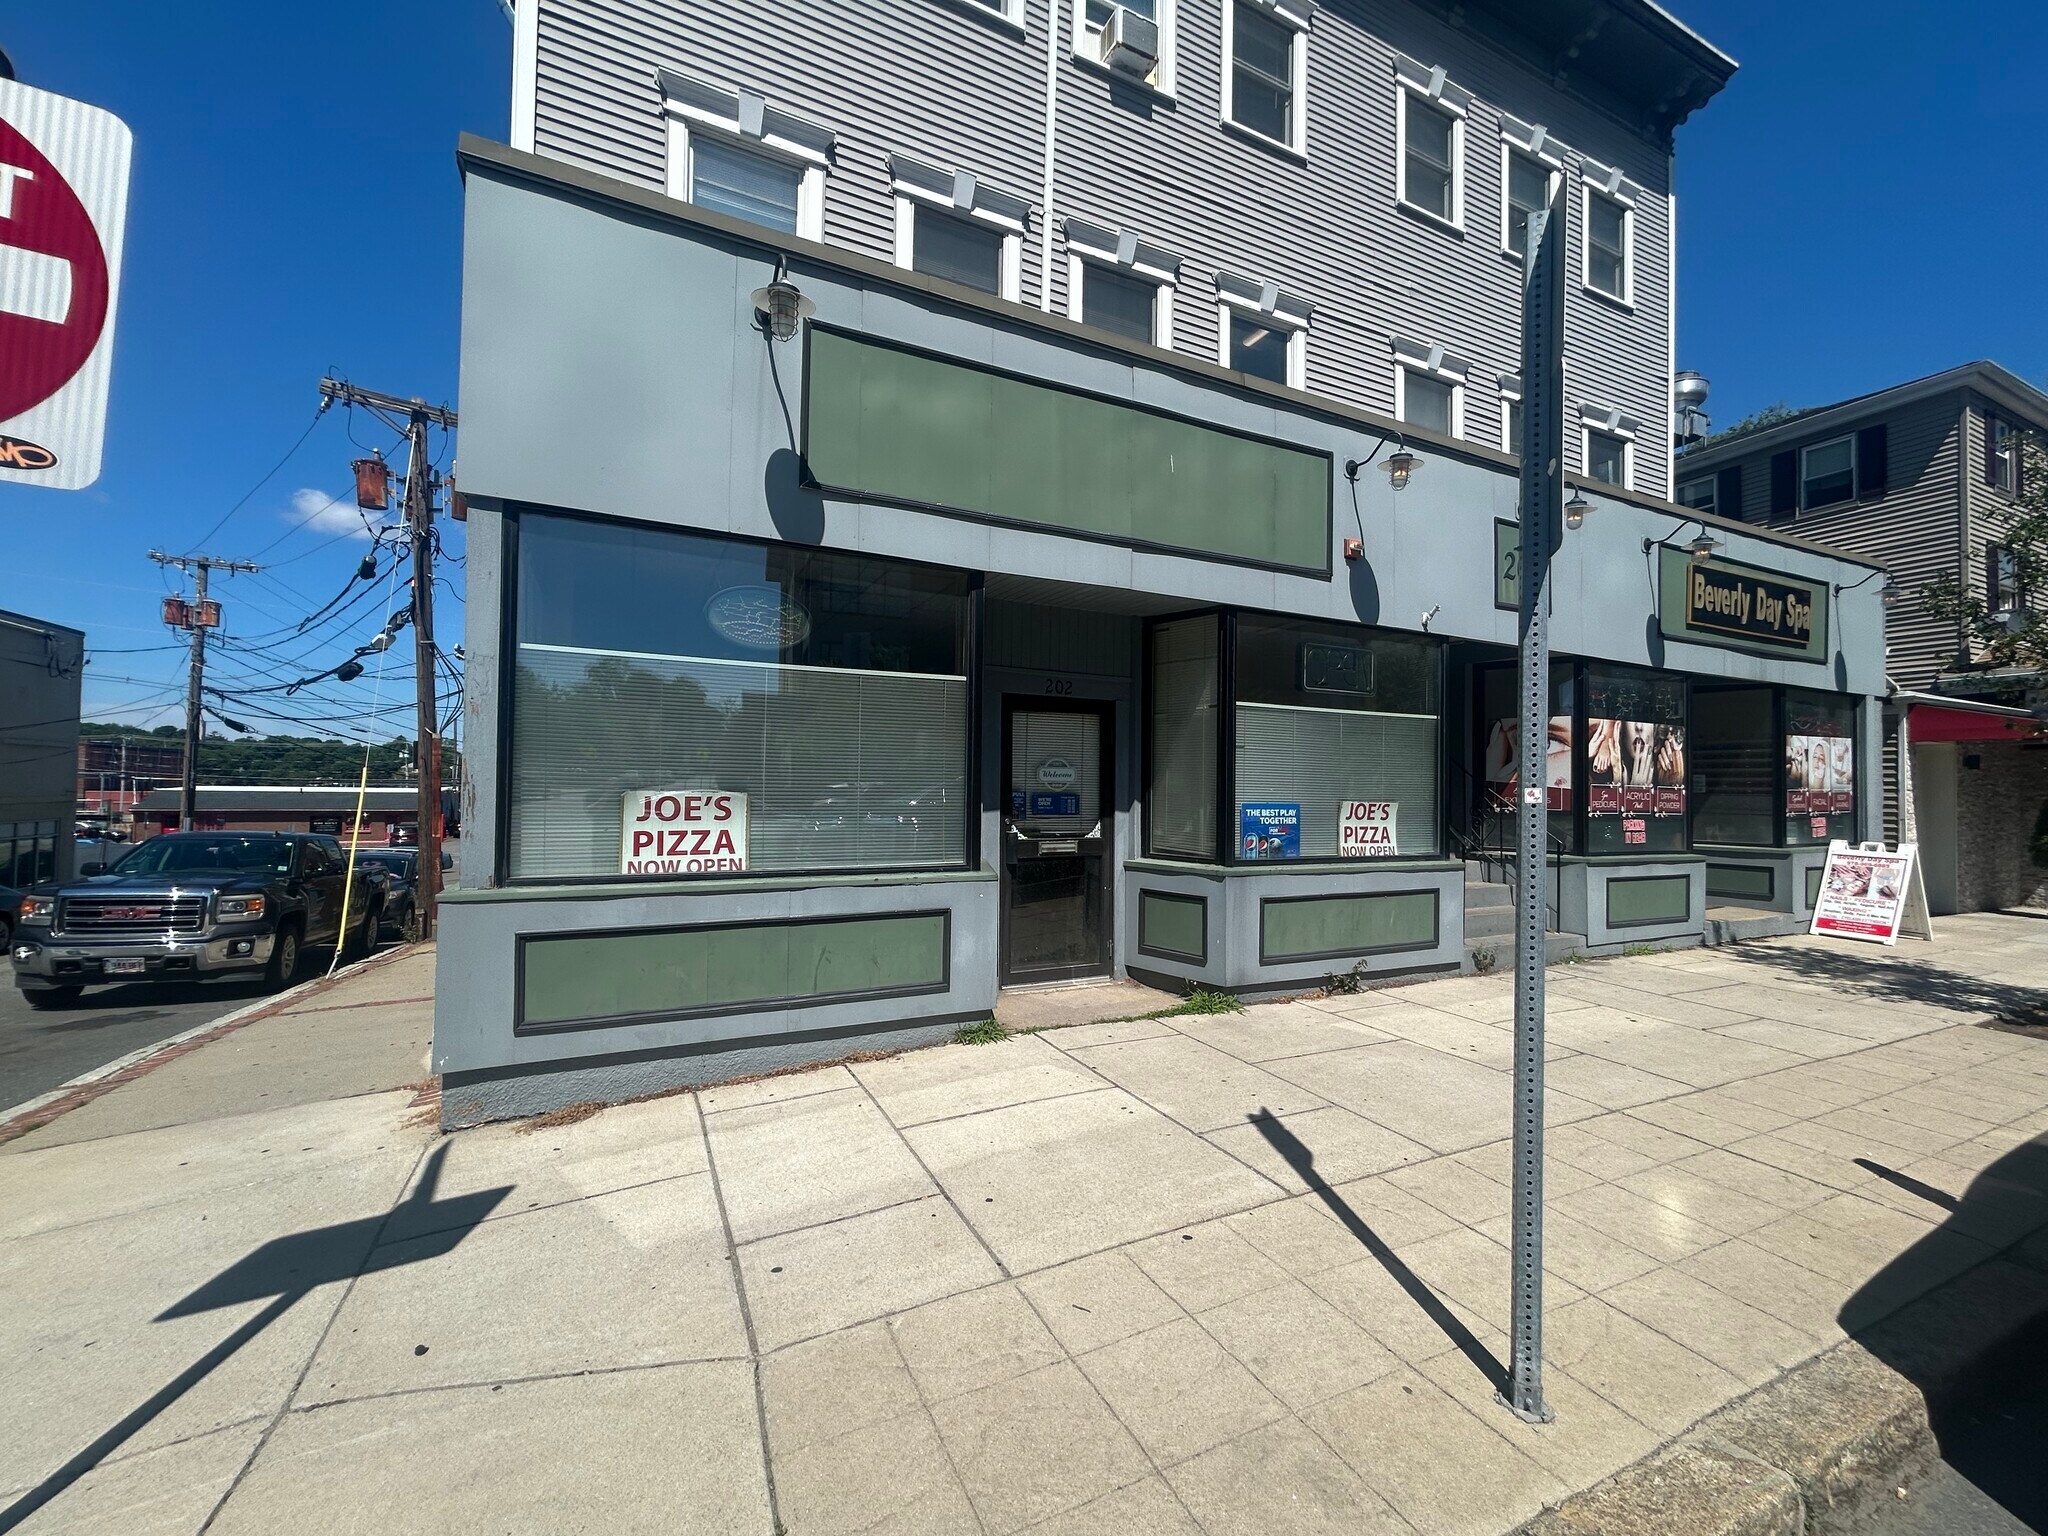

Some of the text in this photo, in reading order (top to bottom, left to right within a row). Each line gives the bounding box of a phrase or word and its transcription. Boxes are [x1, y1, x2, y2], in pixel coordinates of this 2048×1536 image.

[1694, 573, 1810, 635] Beverly Day Spa
[1045, 679, 1073, 695] 202
[1042, 770, 1073, 779] Welcome
[1660, 792, 1679, 800] DIPPING
[636, 795, 732, 822] JOE'S
[1592, 800, 1617, 808] PEDICURE
[1659, 801, 1681, 809] POWDER
[1246, 809, 1297, 817] THE BEST PLAY
[1345, 802, 1391, 821] JOE'S
[1260, 817, 1297, 825] TOGETHER
[1343, 826, 1392, 844] PIZZA
[632, 829, 736, 857] PIZZA
[1342, 846, 1396, 857] NOW OPEN
[626, 857, 743, 875] NOW OPEN
